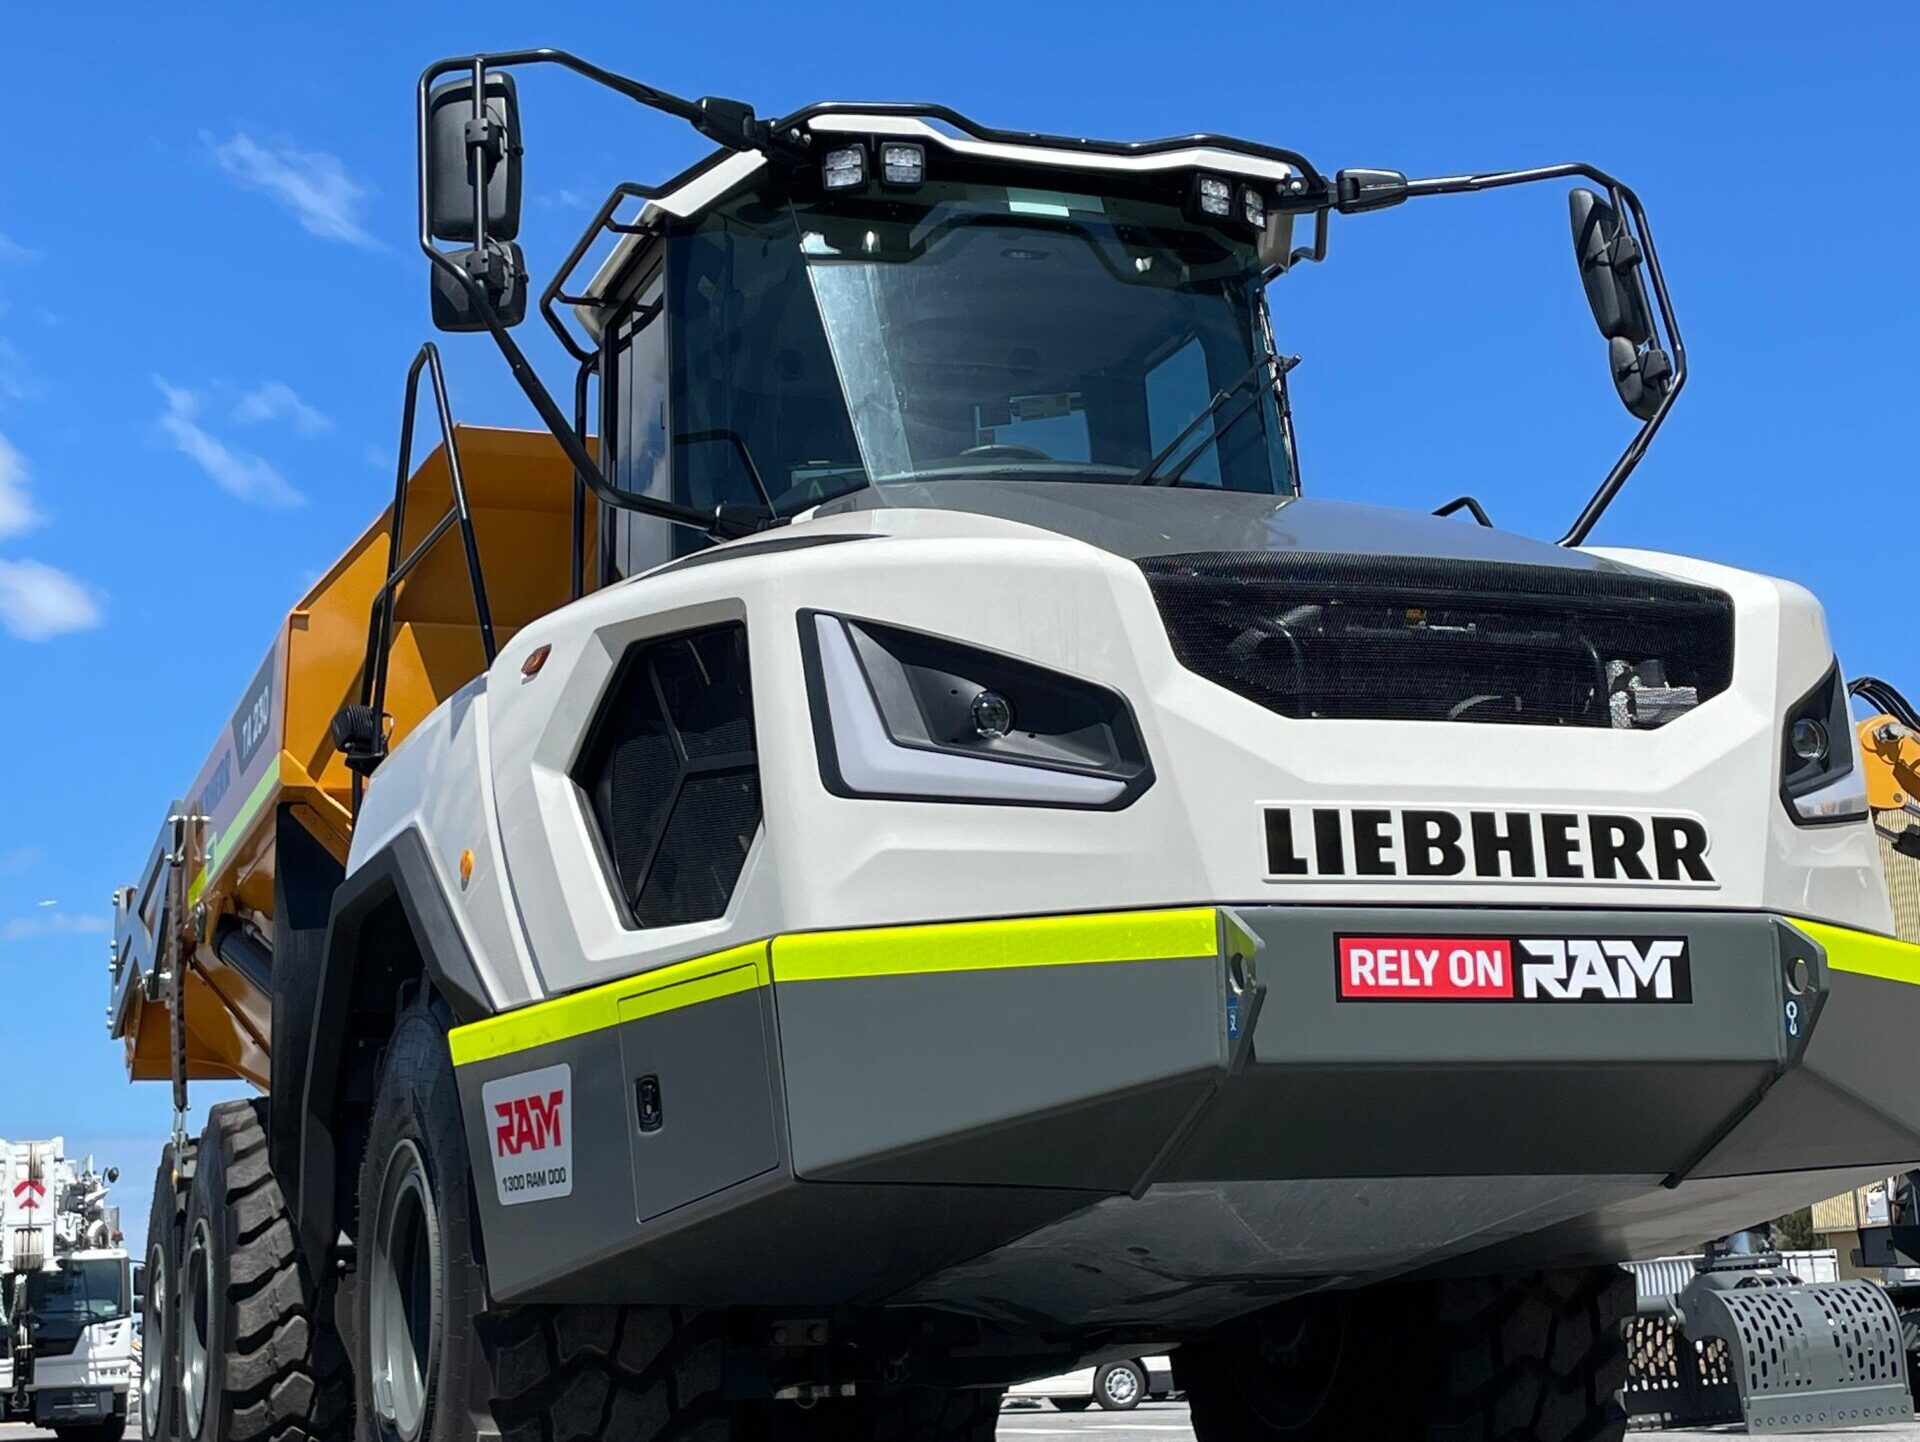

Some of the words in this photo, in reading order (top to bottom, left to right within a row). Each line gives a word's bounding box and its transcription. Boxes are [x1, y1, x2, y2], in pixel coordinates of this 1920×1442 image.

[242, 714, 252, 760] TA
[1263, 807, 1715, 882] LIEBHERR
[1350, 948, 1439, 987] RELY
[1449, 948, 1503, 988] ON
[1518, 940, 1685, 999] RAM
[494, 1090, 564, 1158] RAM
[502, 1173, 525, 1193] 1300
[526, 1169, 546, 1189] RAM
[548, 1166, 566, 1185] 000
